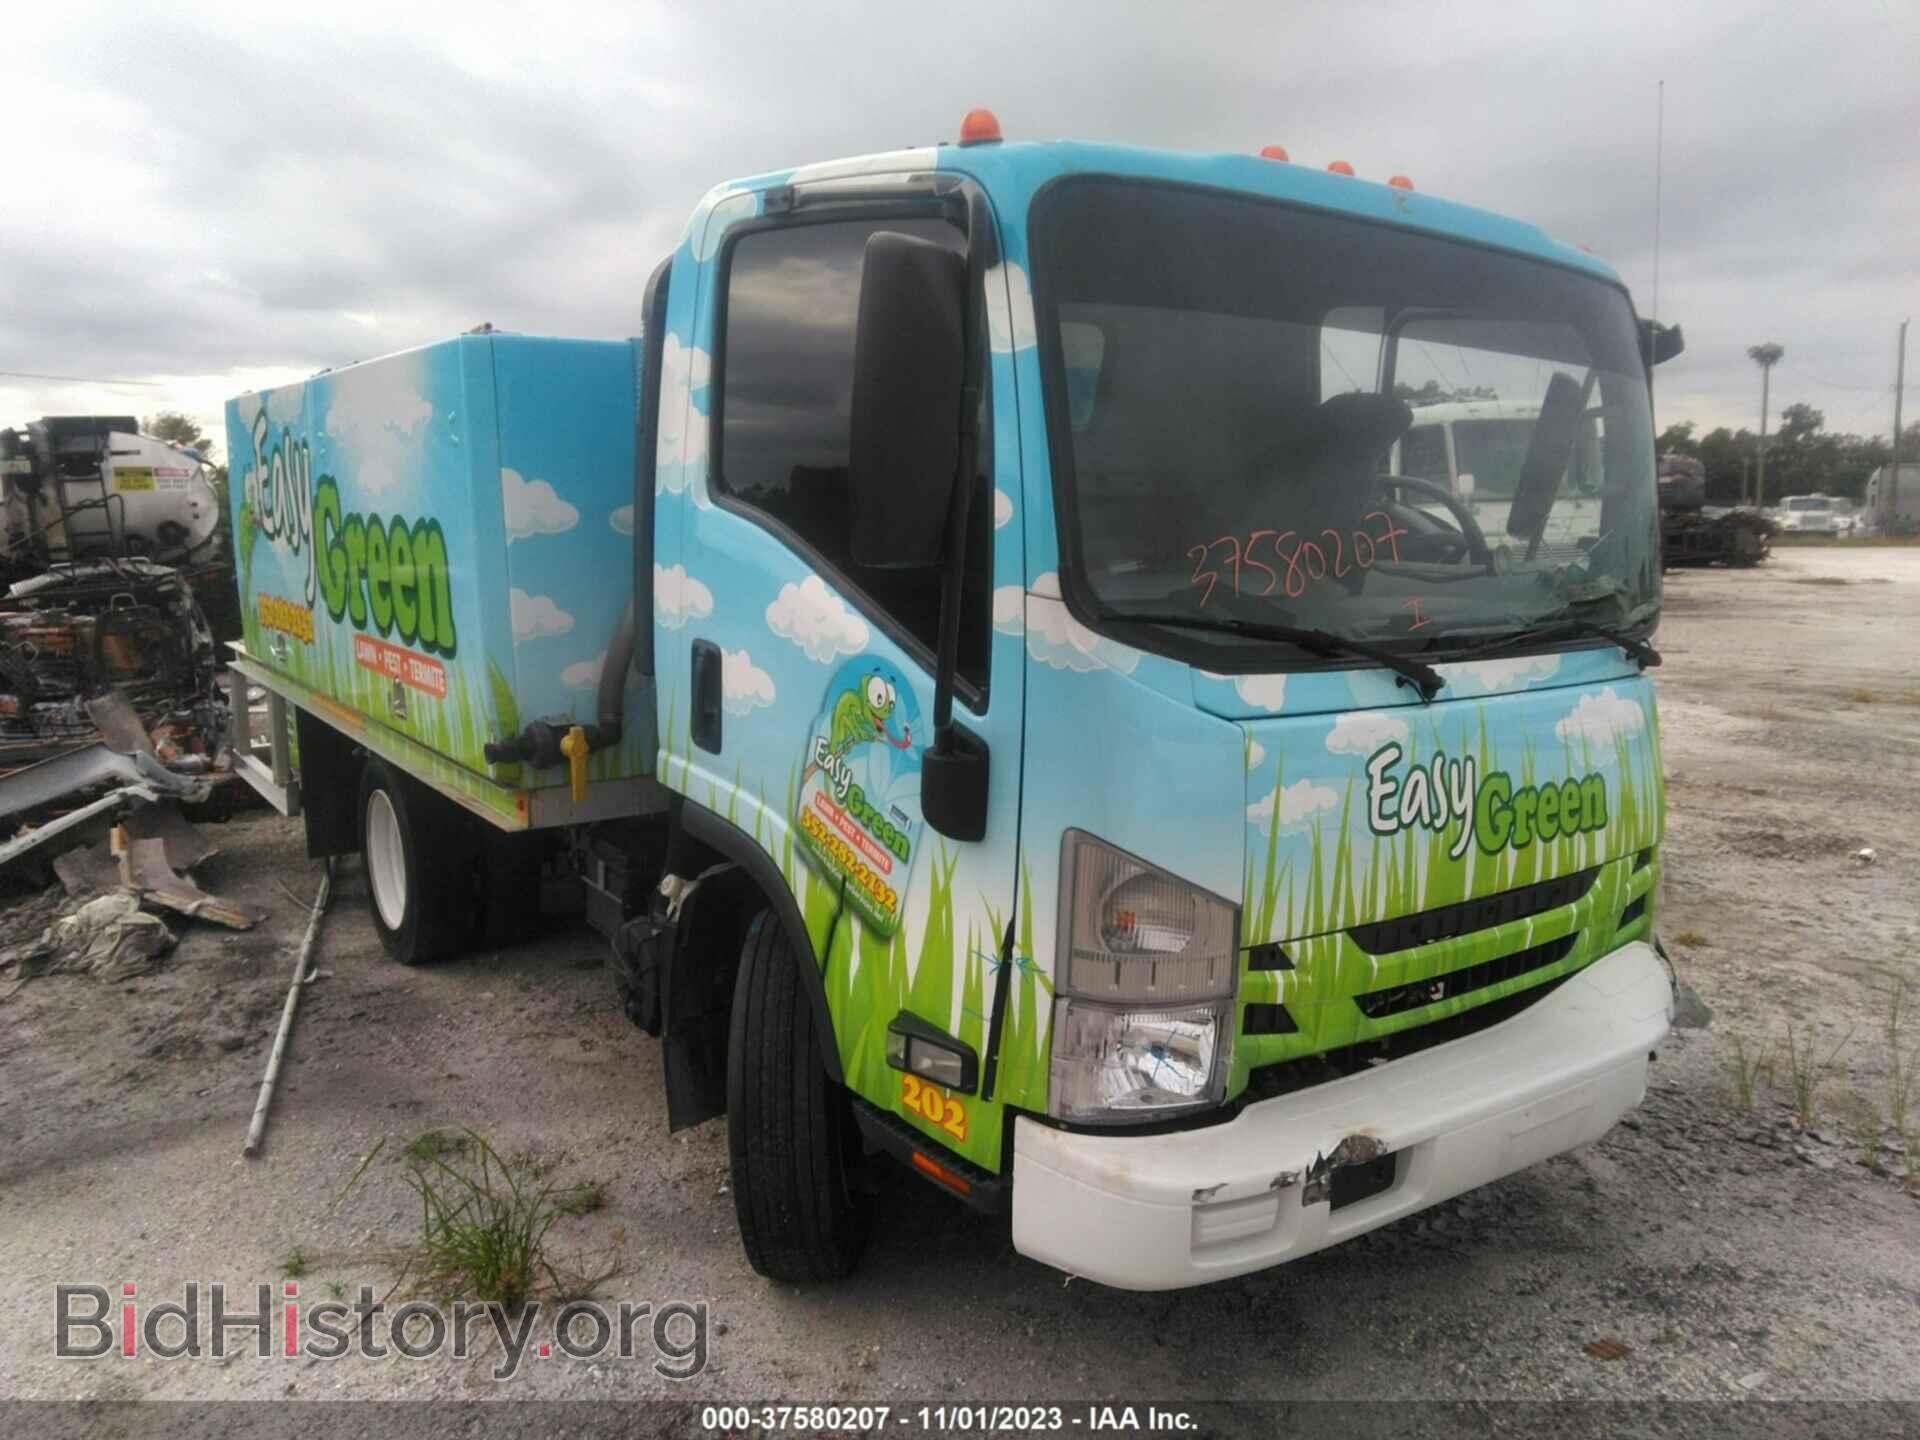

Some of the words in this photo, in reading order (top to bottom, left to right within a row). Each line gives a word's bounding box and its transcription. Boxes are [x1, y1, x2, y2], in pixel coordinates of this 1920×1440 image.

[254, 408, 314, 607] Easy
[313, 474, 457, 660] Green
[1187, 511, 1408, 608] 37580207
[408, 657, 446, 694] TERMITE
[815, 737, 853, 801] Easy
[847, 783, 909, 864] Green
[1366, 741, 1476, 861] Easy
[1475, 771, 1608, 856] Green
[902, 1072, 967, 1142] 202
